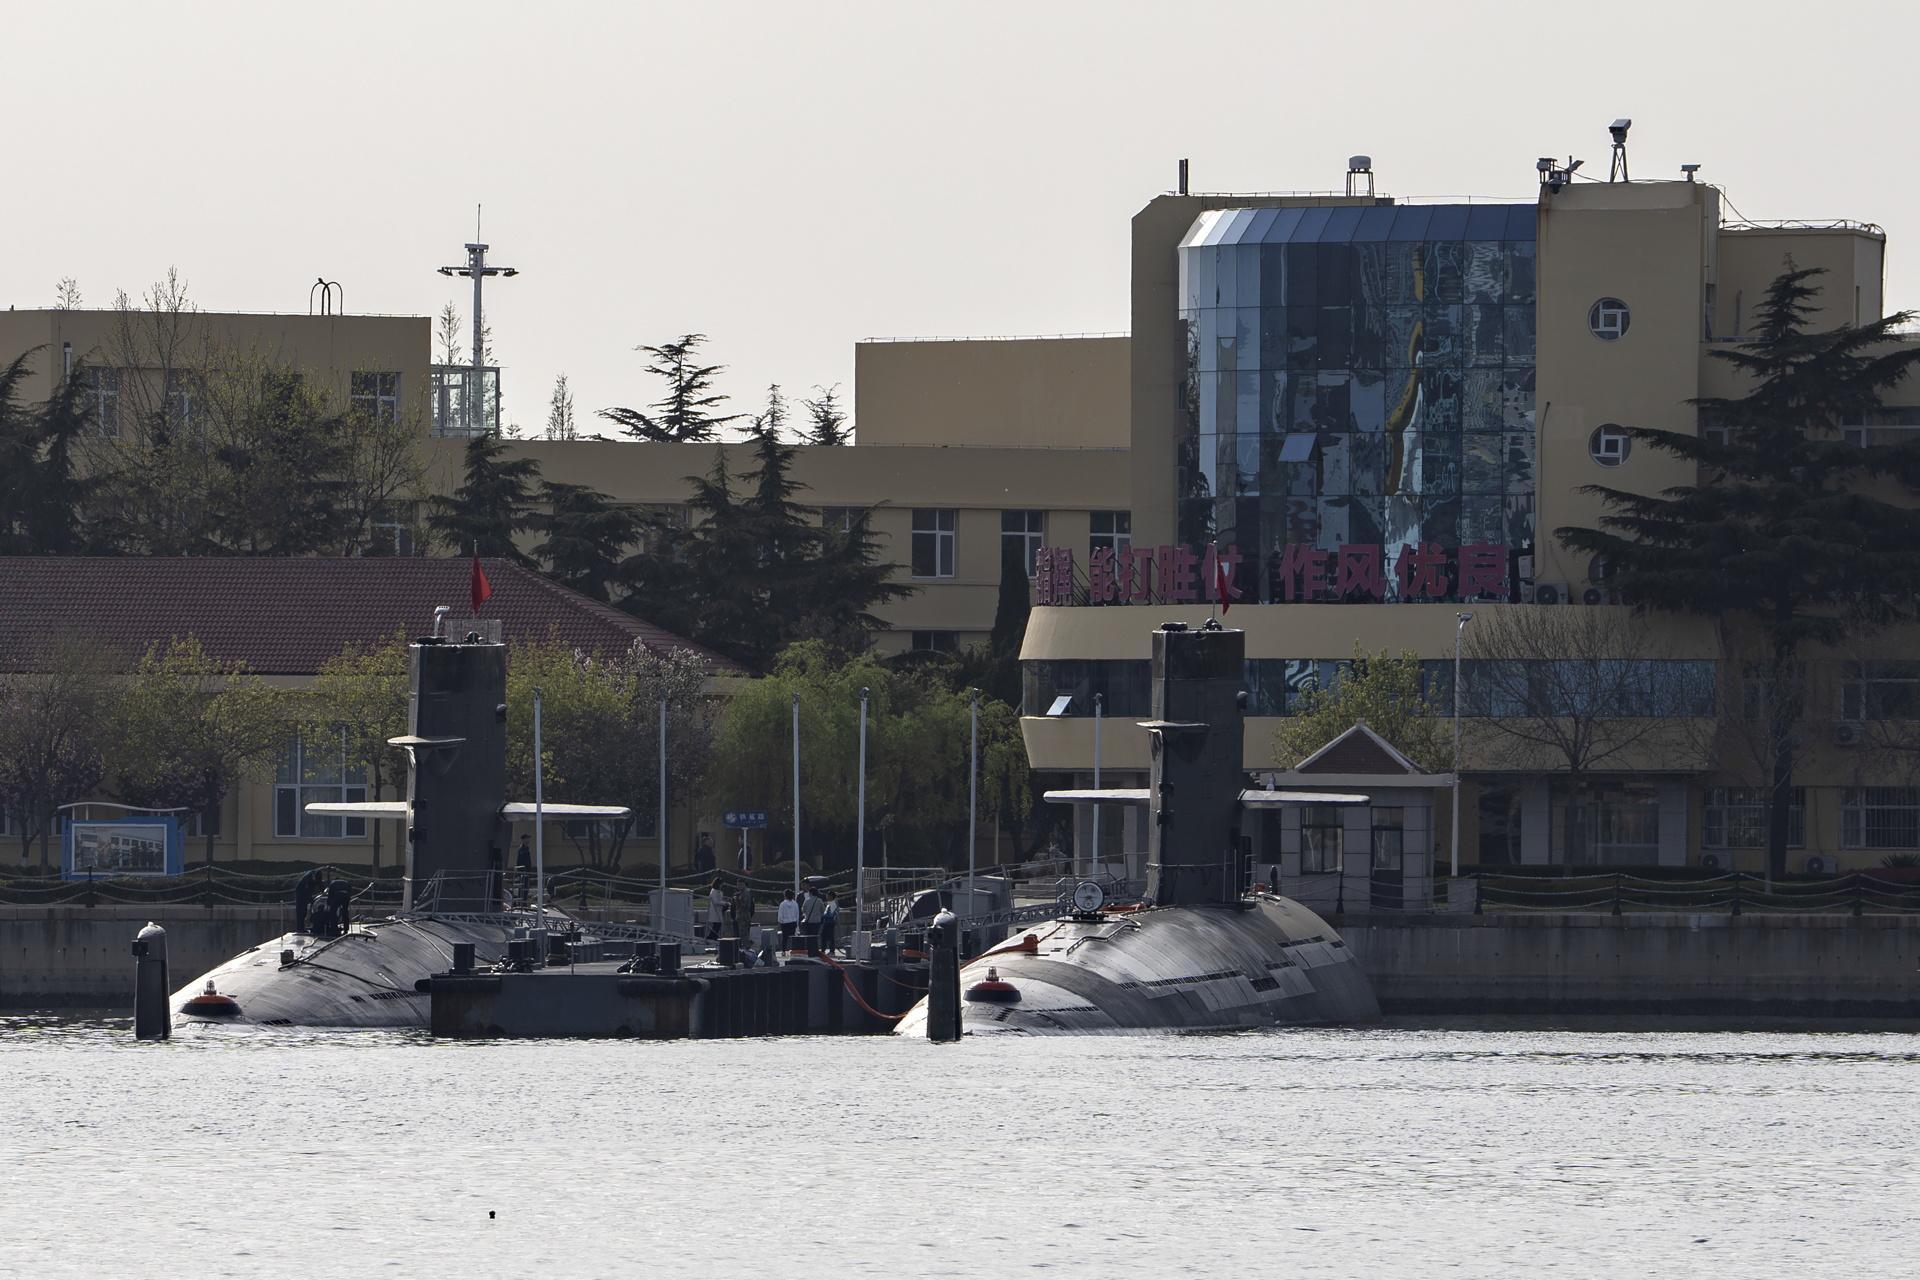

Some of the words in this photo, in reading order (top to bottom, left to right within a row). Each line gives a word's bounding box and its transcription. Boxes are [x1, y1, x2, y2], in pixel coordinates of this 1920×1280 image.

[1089, 543, 1243, 602] 能打胜仗
[1280, 539, 1510, 600] 作风优良
